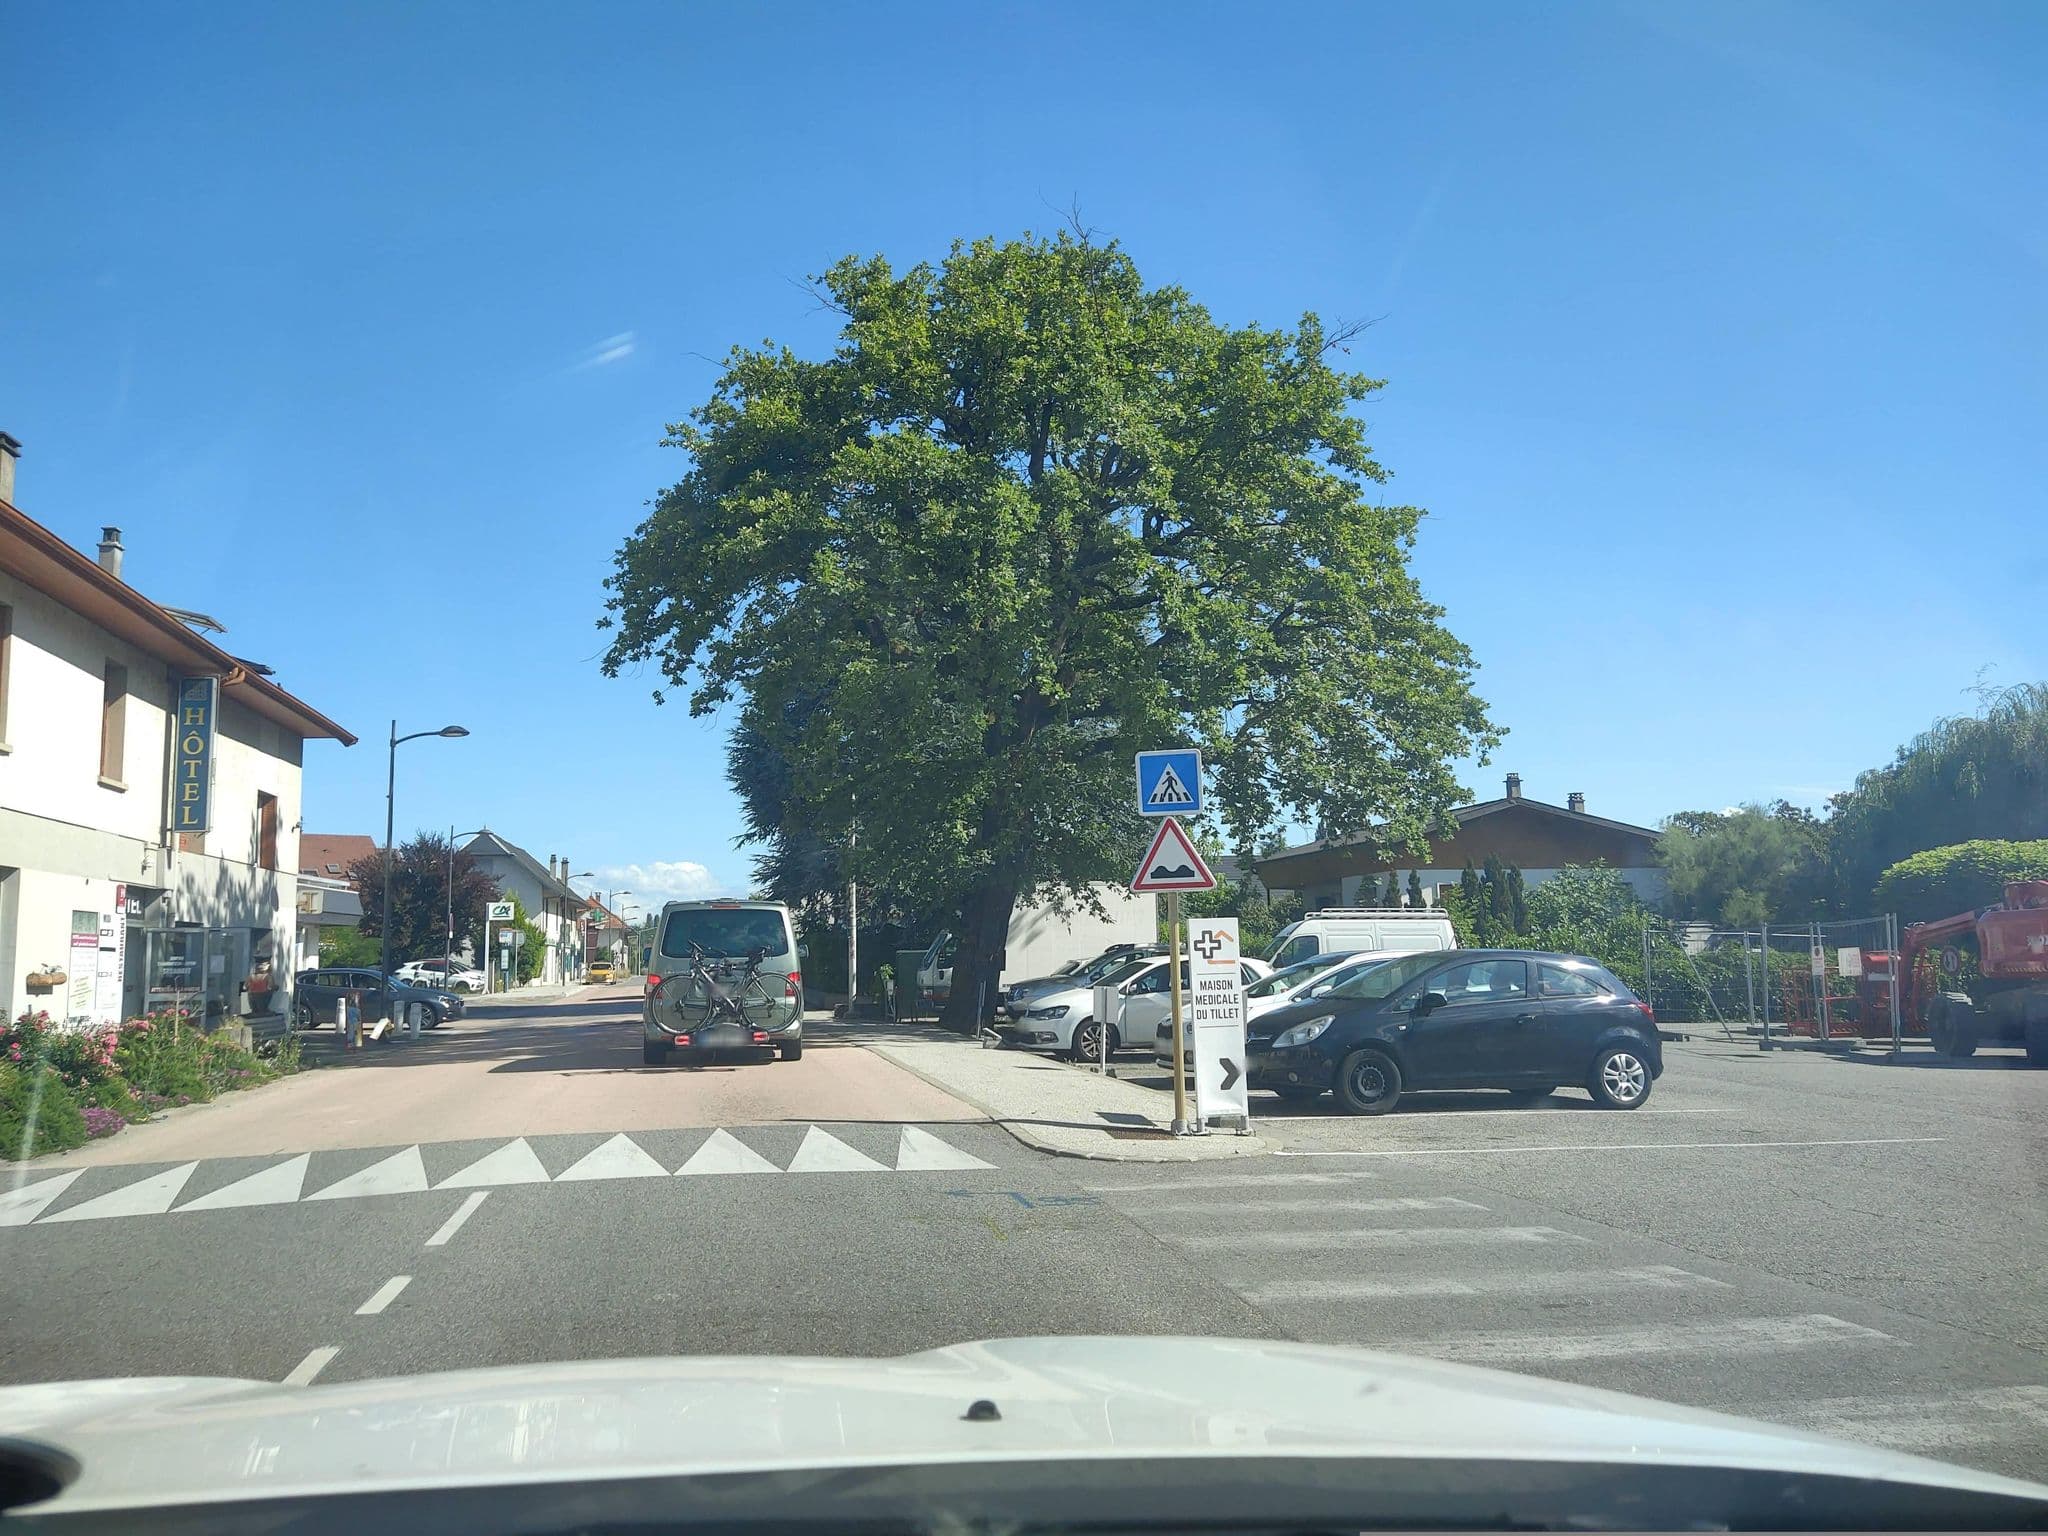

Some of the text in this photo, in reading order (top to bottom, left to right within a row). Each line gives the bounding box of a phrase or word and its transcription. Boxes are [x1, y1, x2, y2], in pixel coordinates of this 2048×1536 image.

[182, 707, 206, 824] HÔTEL
[1200, 980, 1233, 990] MAISON
[1195, 994, 1239, 1005] MEDICALE
[1196, 1008, 1239, 1019] DU TILLET
